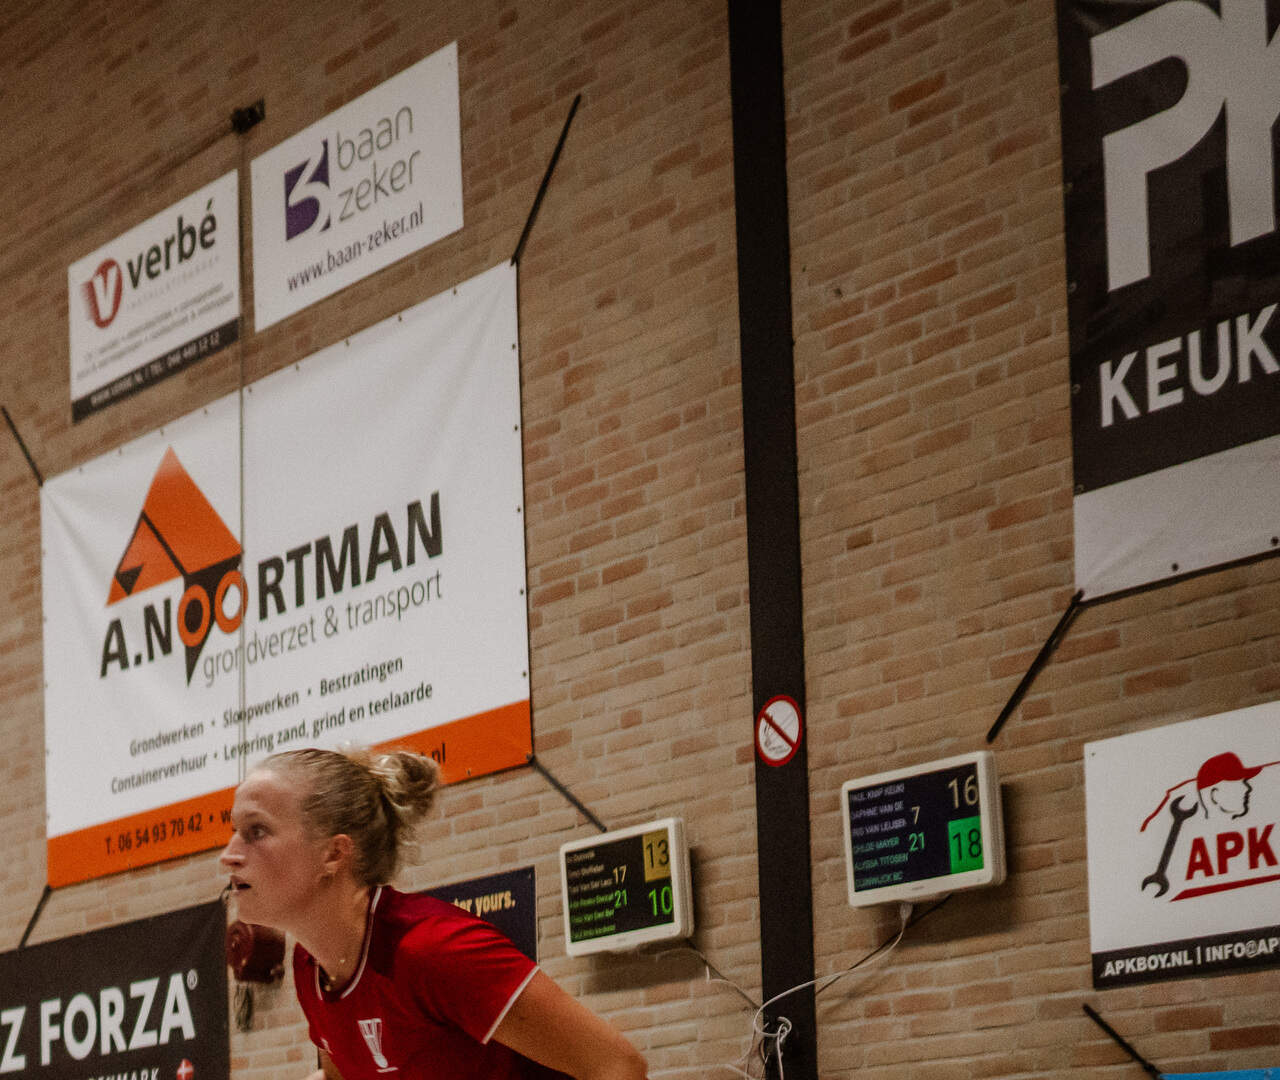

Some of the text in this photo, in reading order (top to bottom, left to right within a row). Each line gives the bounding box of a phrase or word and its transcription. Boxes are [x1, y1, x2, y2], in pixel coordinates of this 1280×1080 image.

[336, 105, 414, 172] baan
[338, 149, 421, 223] zeker
[127, 197, 217, 290] verbé
[287, 202, 424, 292] www.baan-zeker.nl
[1099, 303, 1280, 428] KEUK
[100, 491, 443, 679] A.NOORTMAN
[203, 615, 316, 688] grondverzet
[346, 570, 443, 631] transport
[129, 656, 403, 757] Grondwerken Sloopwerken Bestratingen
[111, 753, 208, 795] Containerverhuur
[224, 733, 274, 761] Levering
[313, 706, 345, 739] grind
[349, 705, 365, 723] en
[369, 681, 433, 716] teelaarde
[912, 806, 920, 825] 7
[948, 774, 979, 809] 16
[118, 832, 132, 852] 06
[136, 827, 149, 848] 54
[152, 822, 167, 843] 93
[170, 818, 184, 837] 70
[188, 812, 202, 832] 42
[646, 839, 669, 869] 13
[909, 831, 925, 852] 21
[952, 828, 982, 861] 18
[1185, 823, 1279, 881] APK
[612, 864, 627, 885] 17
[614, 889, 627, 908] 21
[648, 885, 673, 916] 10
[1103, 949, 1193, 978] APKBOY.NL
